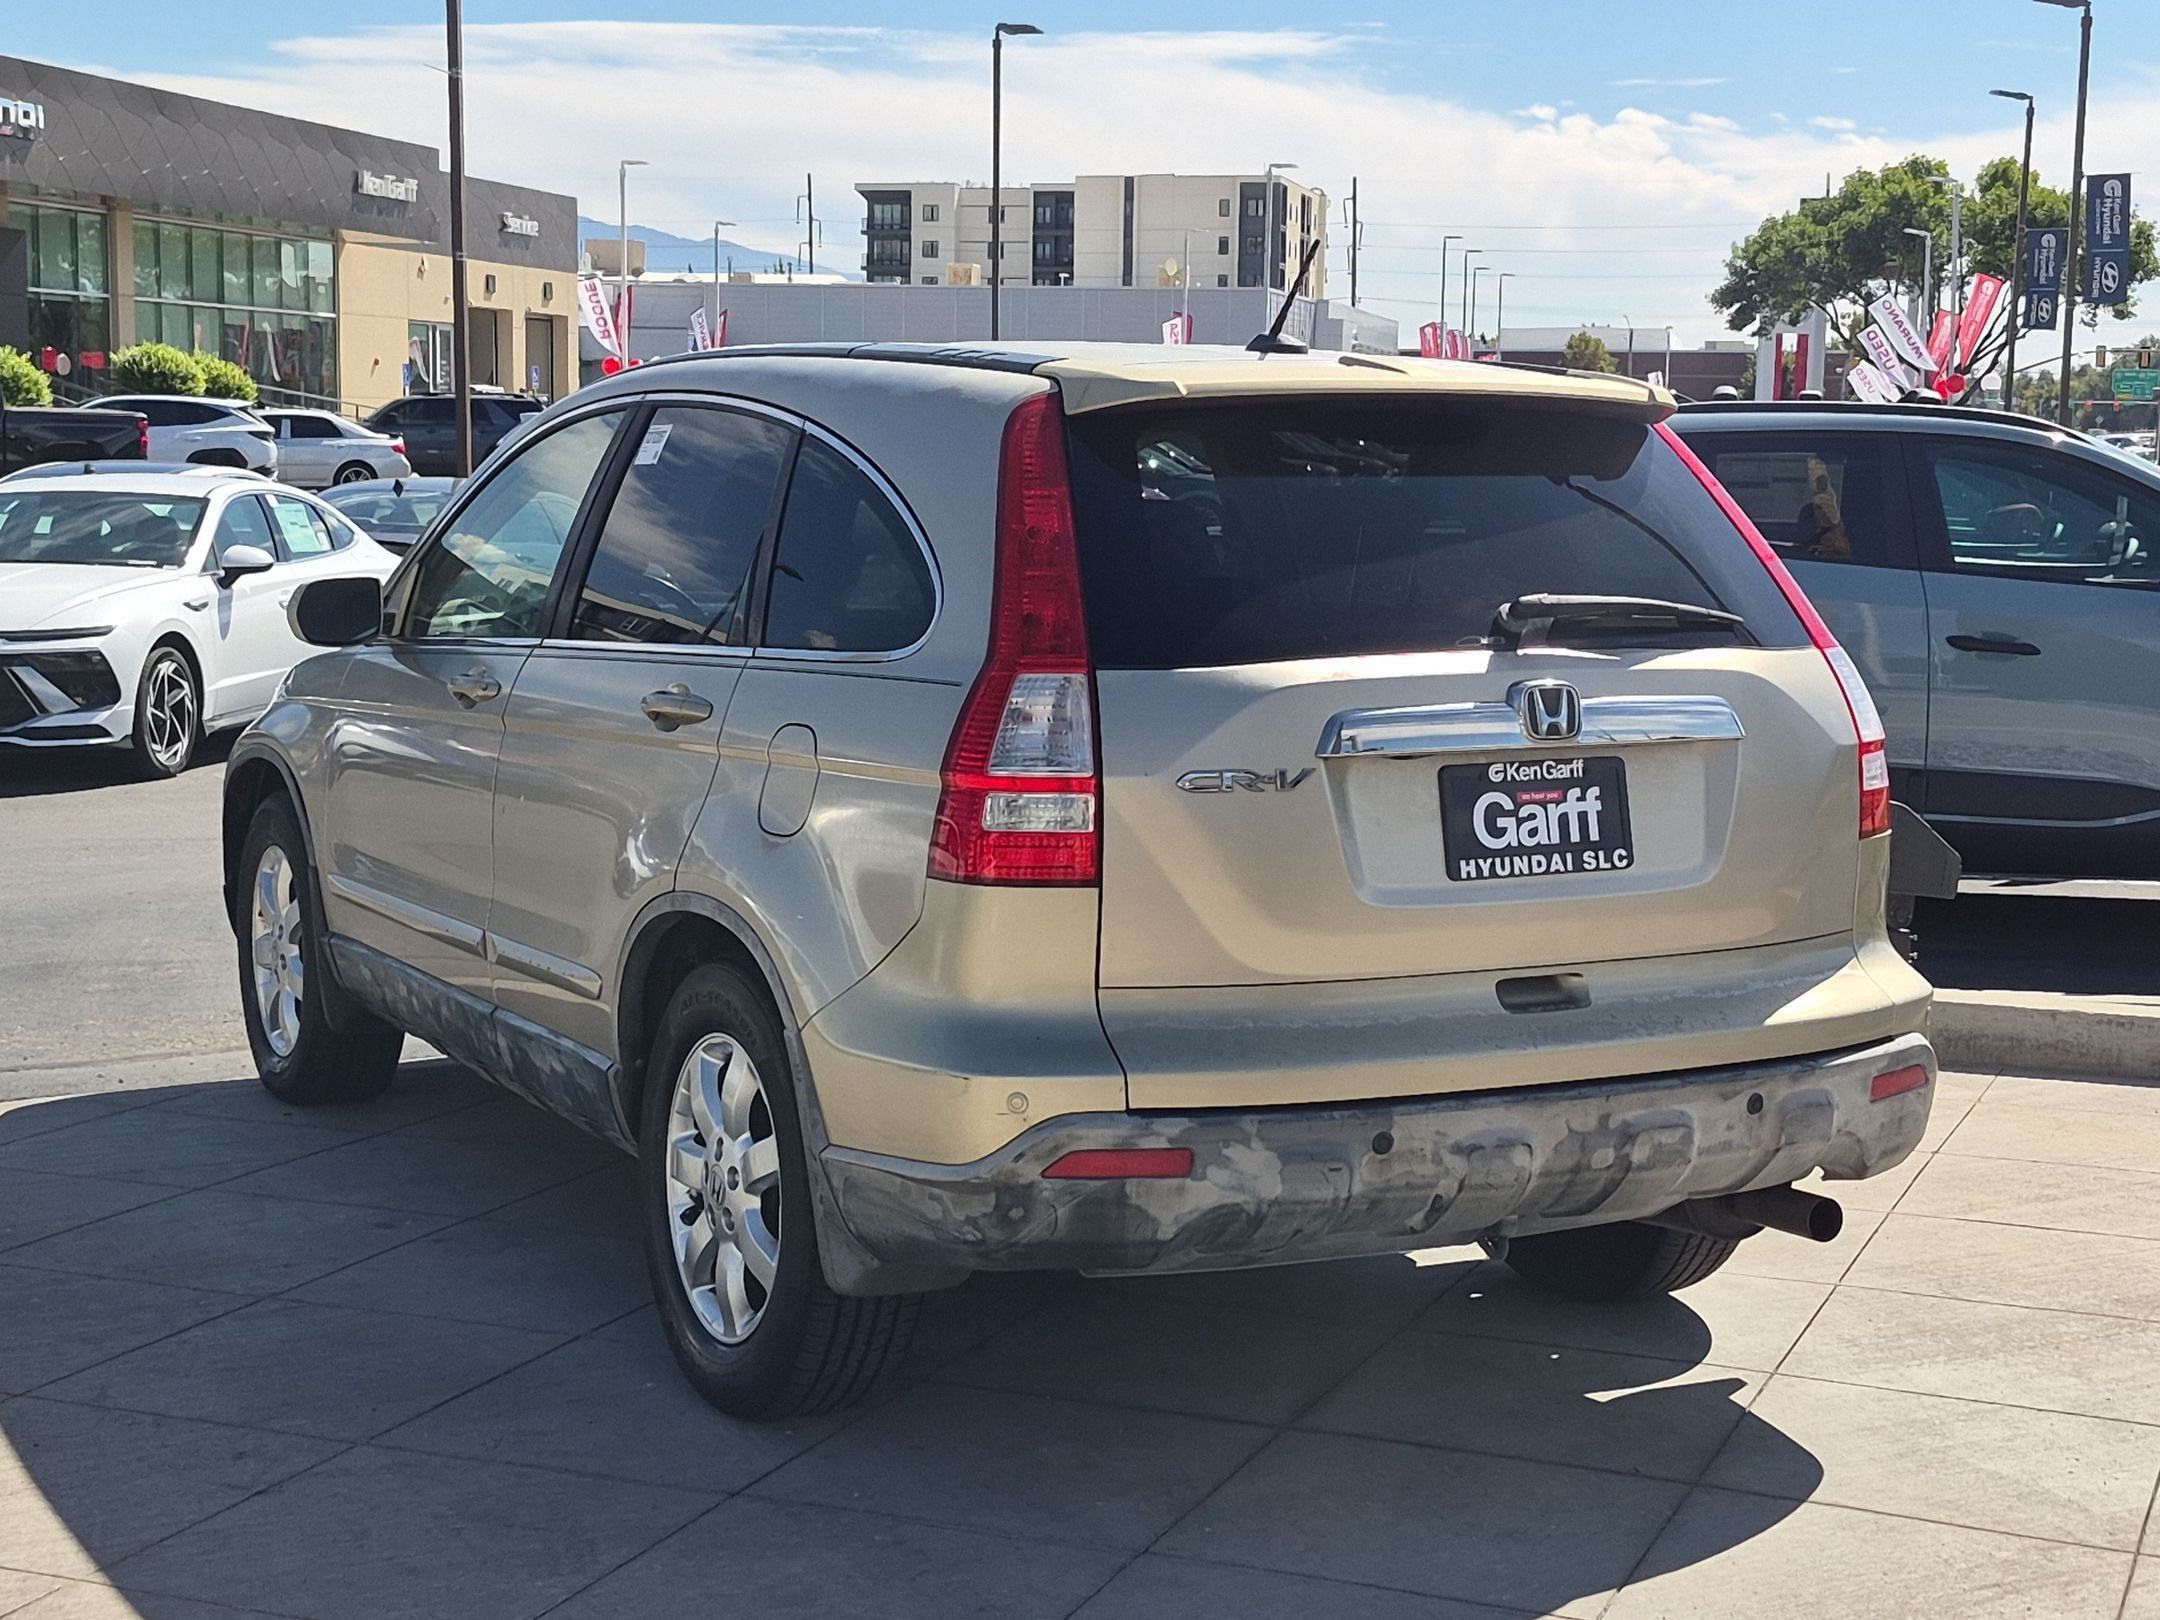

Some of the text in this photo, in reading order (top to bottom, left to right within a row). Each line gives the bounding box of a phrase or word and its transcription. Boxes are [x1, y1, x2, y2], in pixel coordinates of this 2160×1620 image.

[1175, 767, 1317, 794] CR-V
[1473, 786, 1602, 849] Garff
[1459, 848, 1629, 880] HYUNDAI SLC
